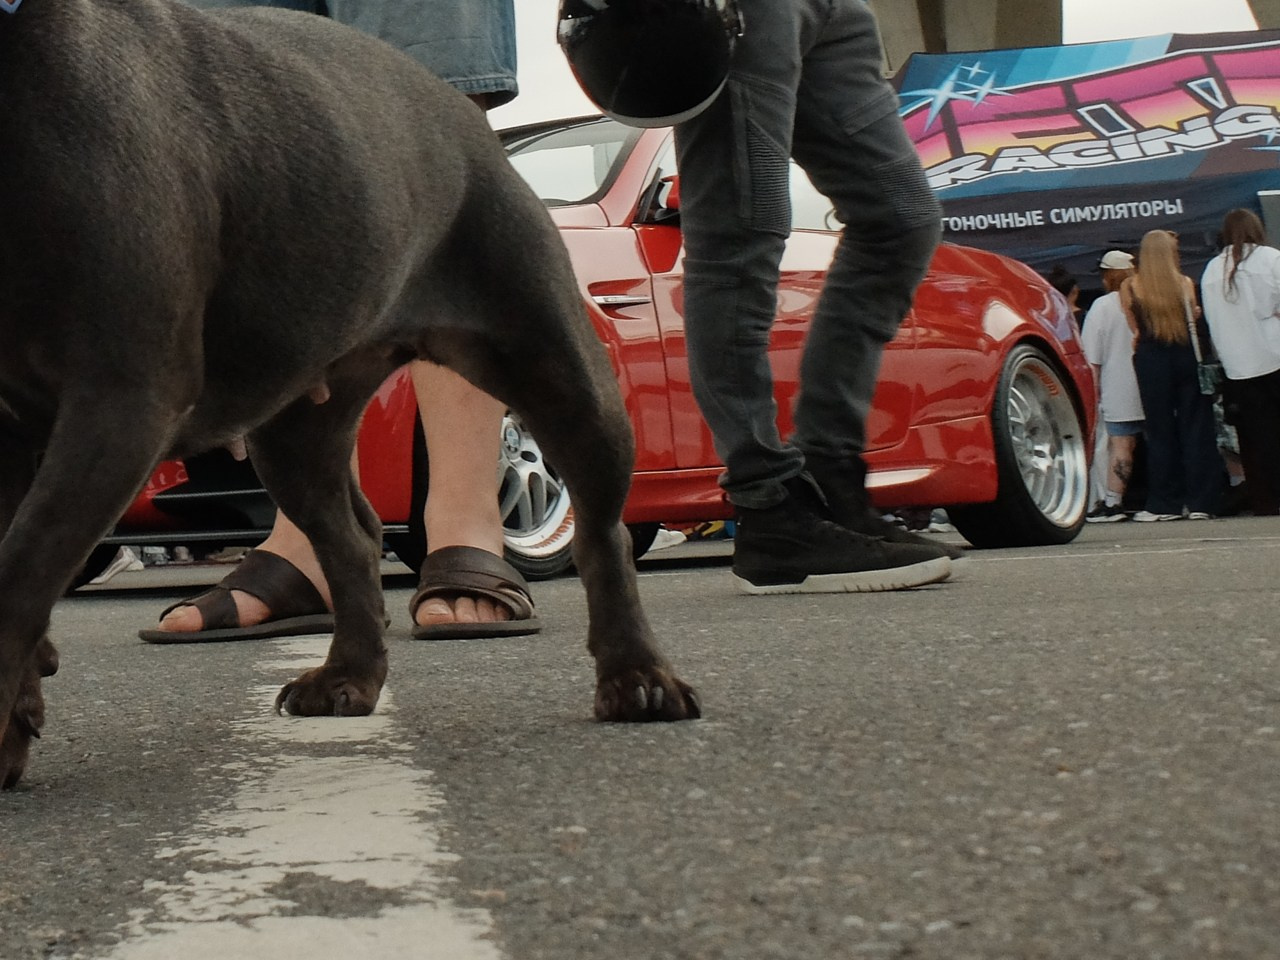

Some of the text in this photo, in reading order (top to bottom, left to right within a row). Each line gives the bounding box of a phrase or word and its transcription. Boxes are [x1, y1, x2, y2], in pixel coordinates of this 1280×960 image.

[923, 104, 1280, 191] RACING
[941, 198, 1184, 232] ГОНОЧНЫЕ СИМУЛЯТОРЫ
